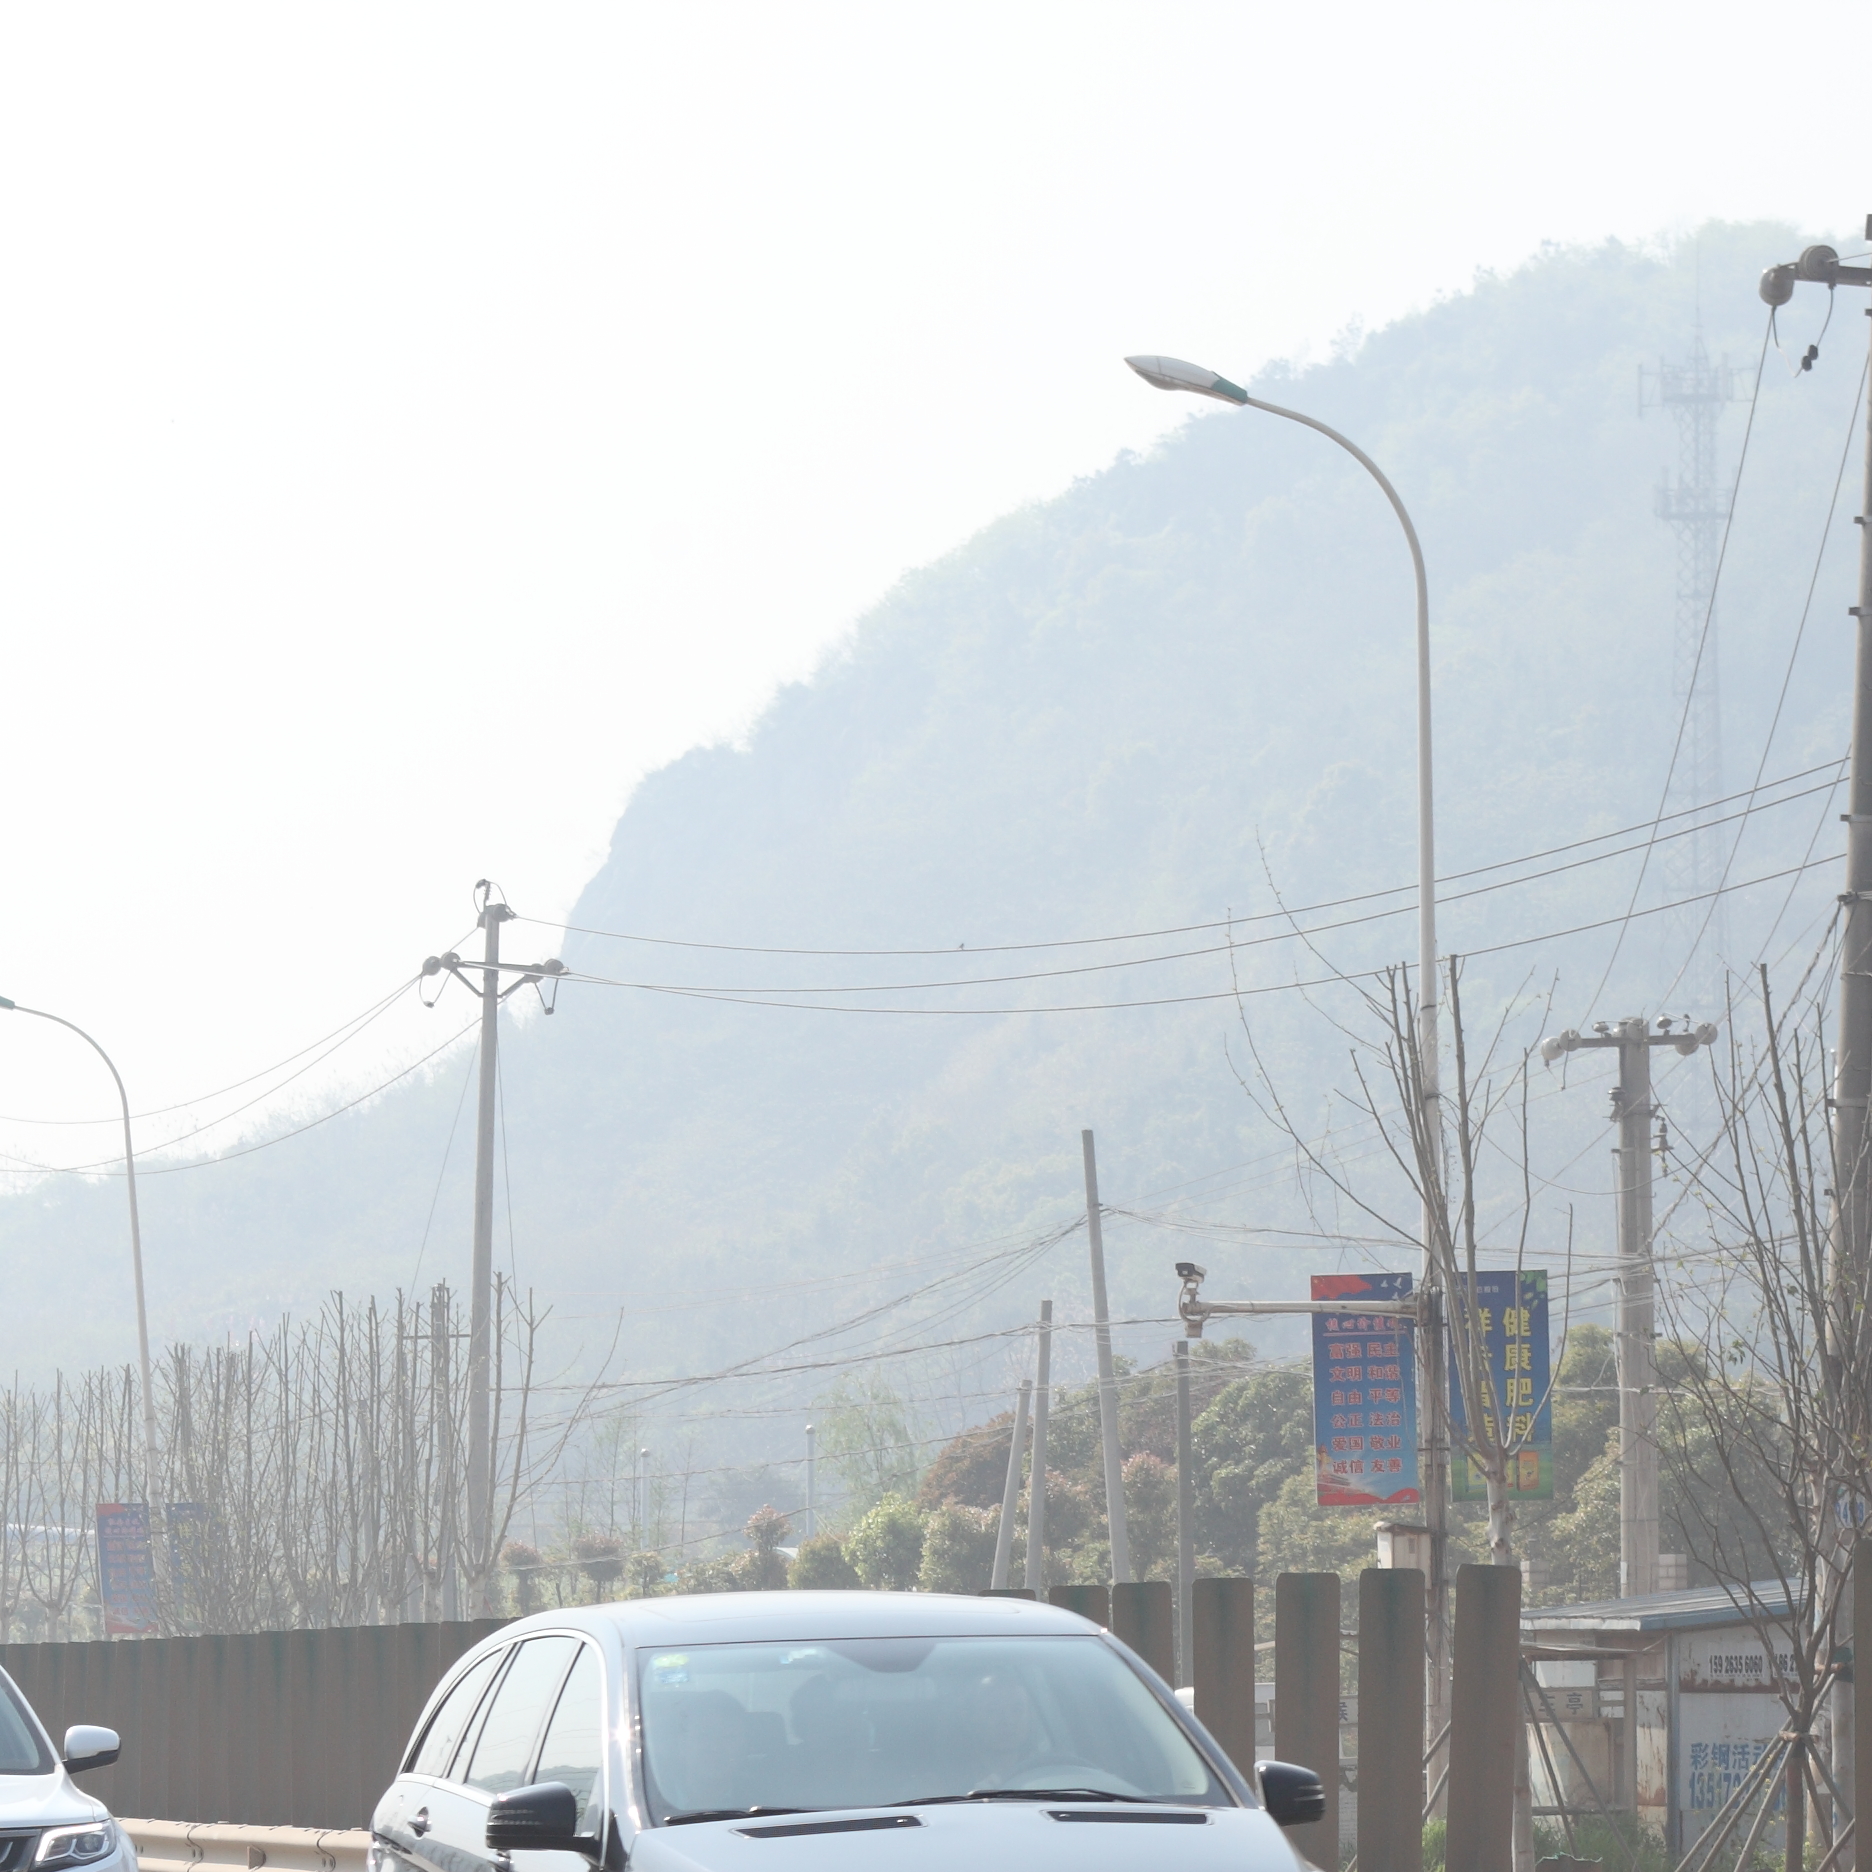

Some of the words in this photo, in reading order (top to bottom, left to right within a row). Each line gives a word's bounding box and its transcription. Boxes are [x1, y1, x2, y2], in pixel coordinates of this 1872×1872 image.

[1329, 1342, 1362, 1359] 富强
[1367, 1342, 1399, 1357] 民主
[1329, 1366, 1362, 1382] 文明
[1368, 1364, 1400, 1380] 和谐
[1503, 1306, 1534, 1443] 健康肥料
[1331, 1390, 1362, 1405] 自由
[1369, 1388, 1400, 1403] 平等
[1332, 1413, 1364, 1429] 公正
[1369, 1411, 1401, 1426] 法治
[1332, 1436, 1364, 1451] 爱国
[1369, 1434, 1401, 1450] 敬业
[1333, 1459, 1364, 1475] 诚信
[1370, 1458, 1403, 1473] 友善
[1709, 1655, 1723, 1673] 159
